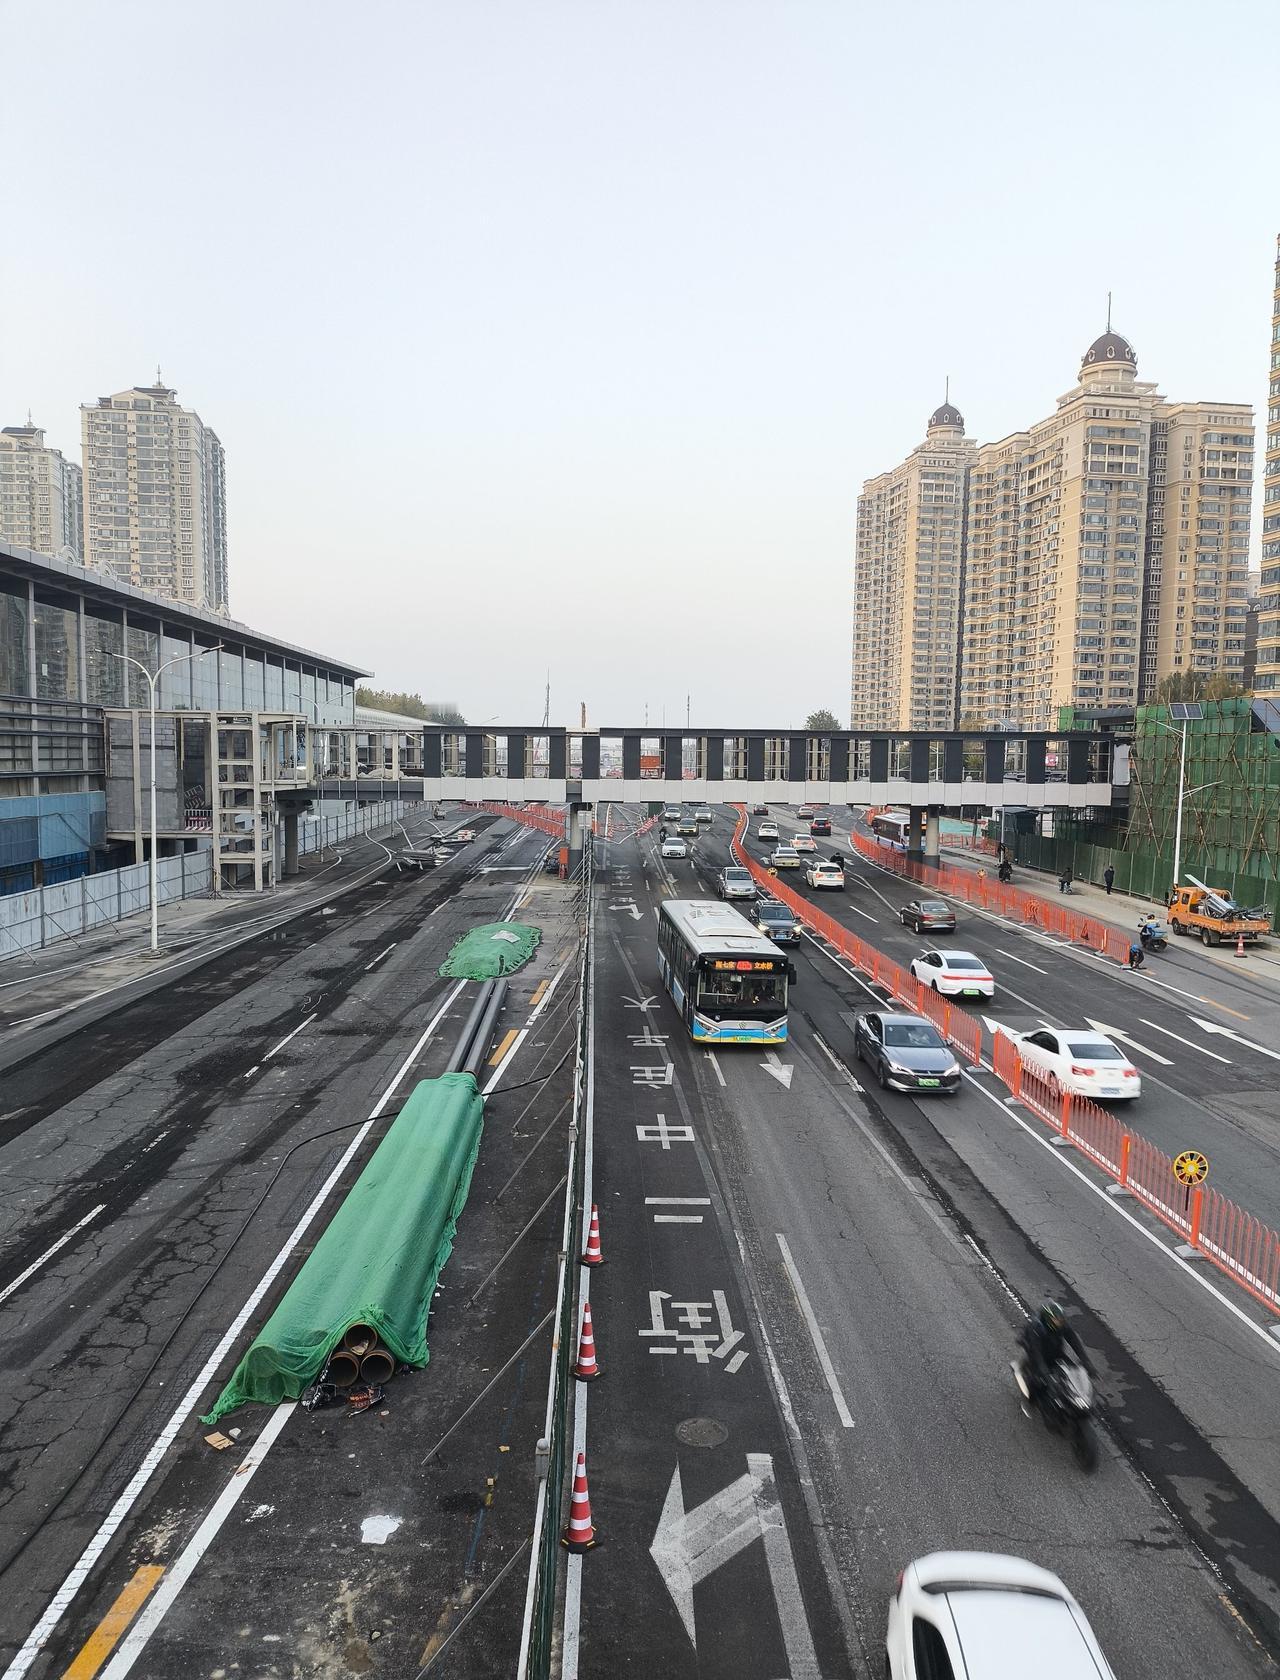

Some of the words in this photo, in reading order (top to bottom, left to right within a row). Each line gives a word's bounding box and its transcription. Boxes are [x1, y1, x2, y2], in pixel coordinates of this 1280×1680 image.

[622, 996, 749, 1372] 太平庄中二街
